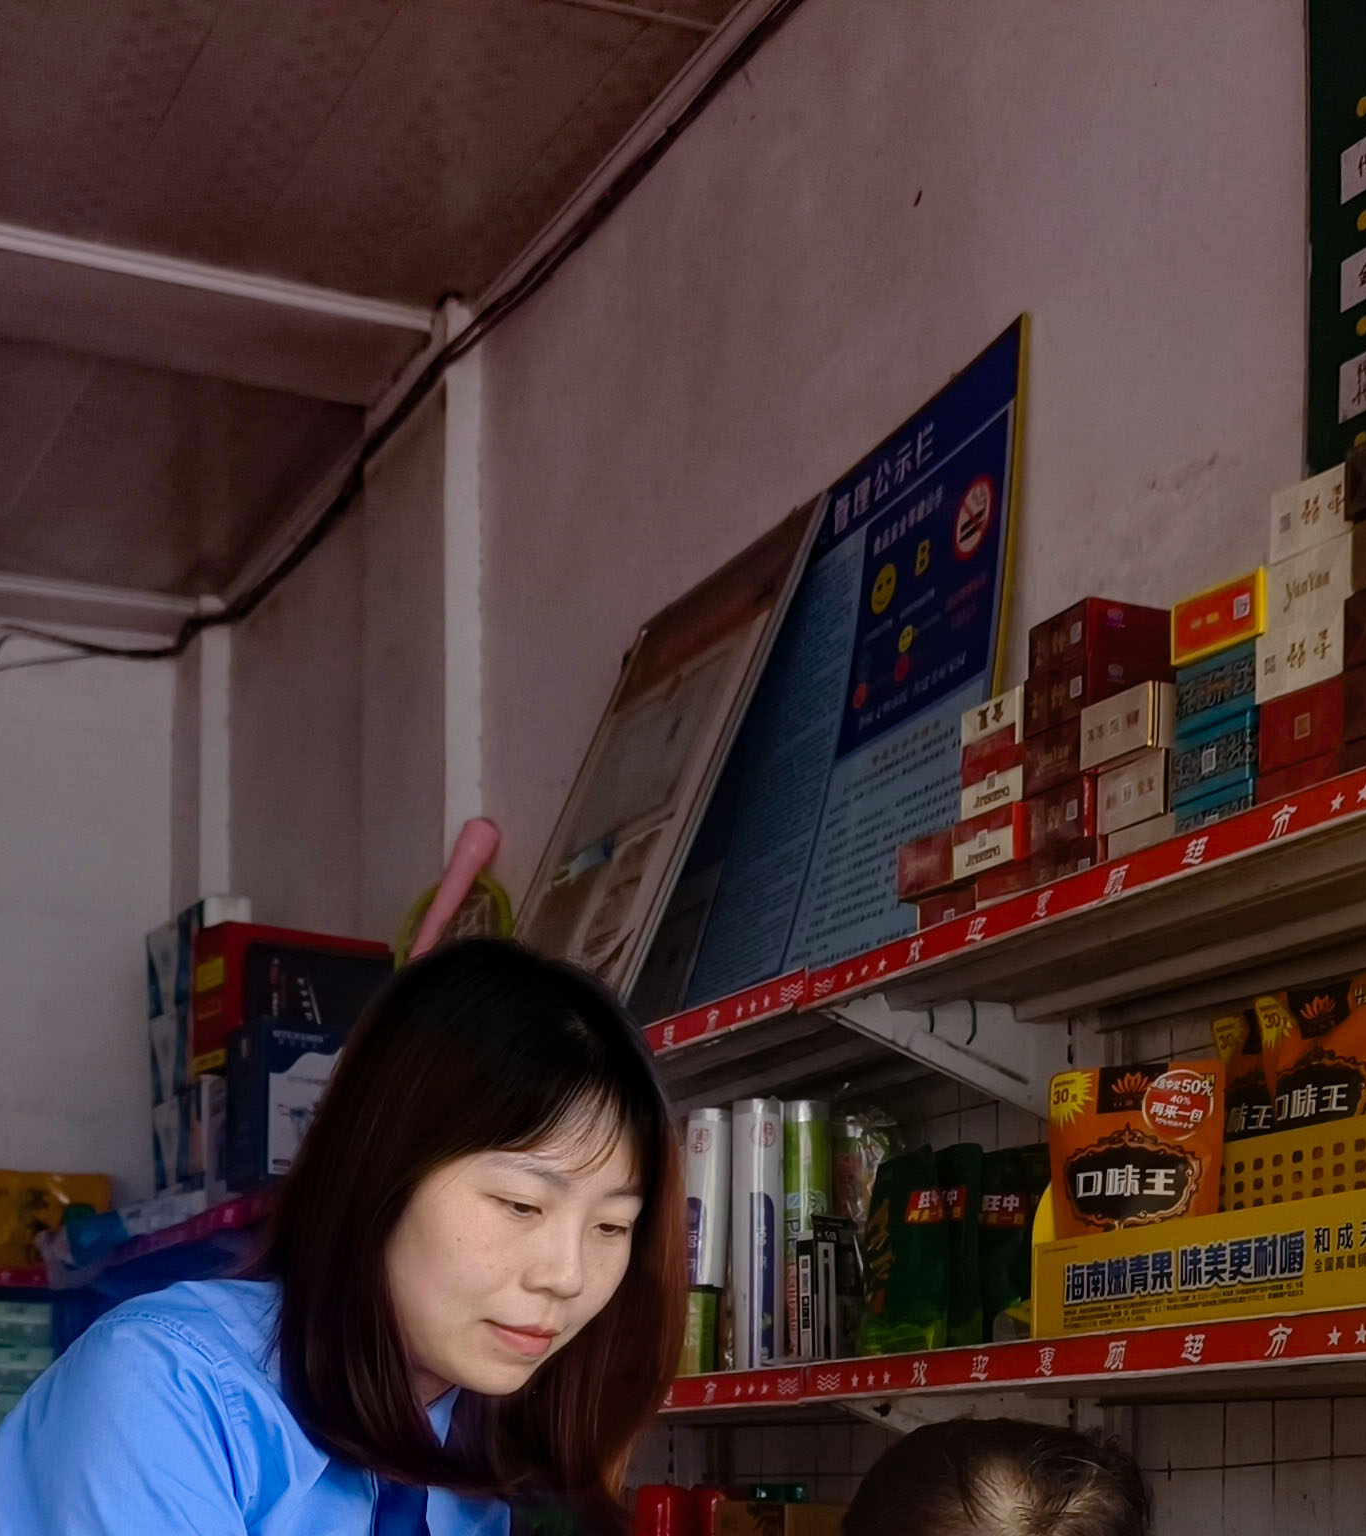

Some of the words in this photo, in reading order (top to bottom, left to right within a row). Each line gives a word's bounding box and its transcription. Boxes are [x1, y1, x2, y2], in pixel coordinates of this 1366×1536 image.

[1149, 1101, 1204, 1123] 再来一包
[1275, 1082, 1349, 1122] 口味王
[1075, 1163, 1176, 1199] 口味王
[1064, 1249, 1174, 1305] 海南嫩青果
[1178, 1229, 1307, 1290] 味美更耐嚼
